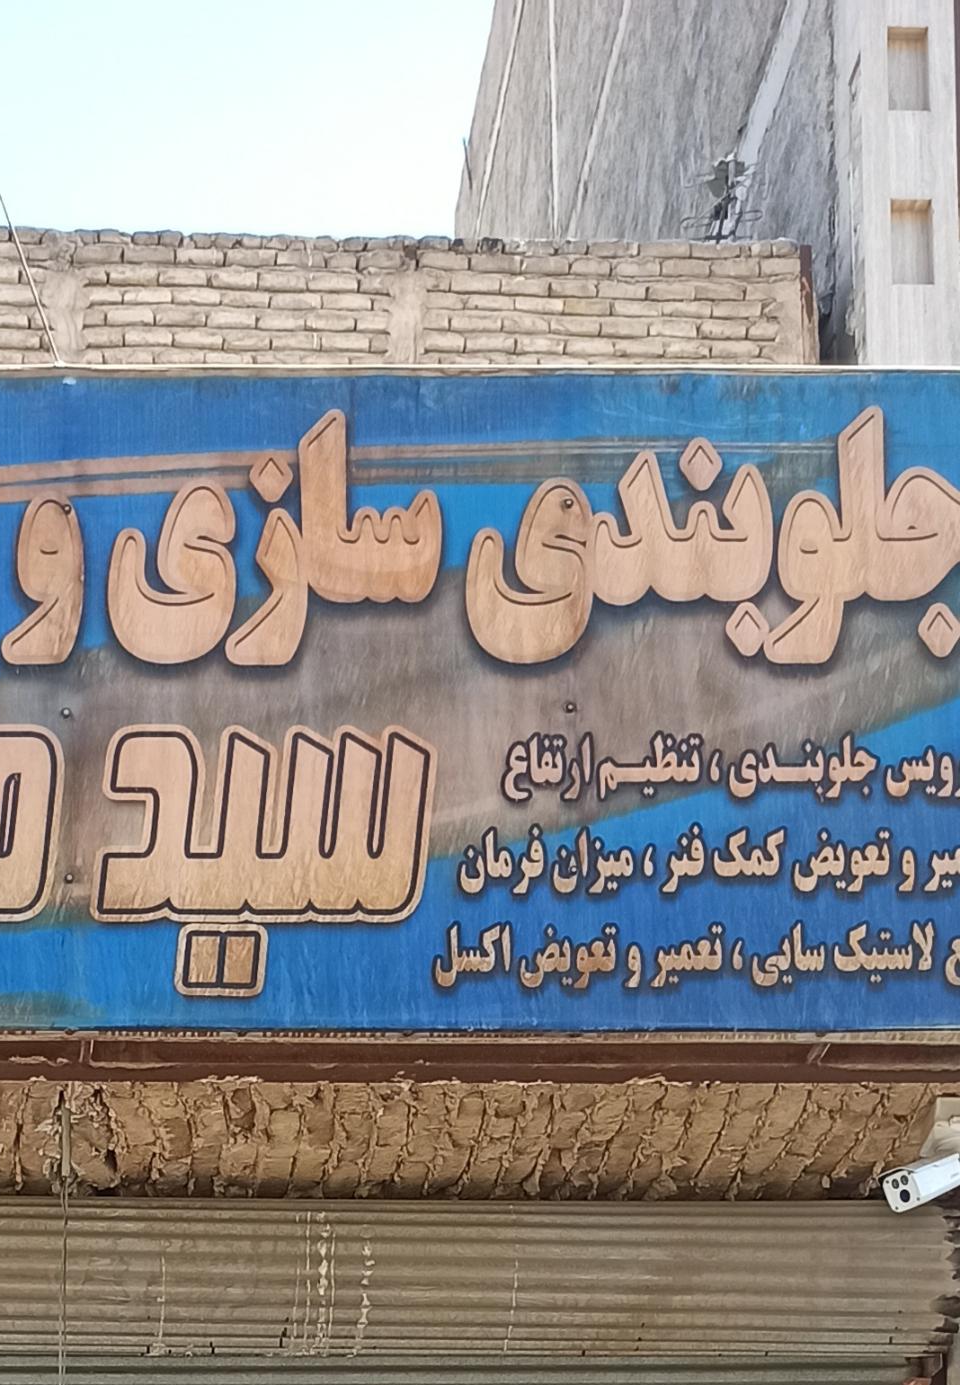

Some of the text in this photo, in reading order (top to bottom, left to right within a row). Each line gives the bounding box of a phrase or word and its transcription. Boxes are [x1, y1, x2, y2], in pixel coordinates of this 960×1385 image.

[107, 408, 440, 665] سازی
[1, 489, 85, 665] و
[501, 731, 593, 802] ارتفاع
[599, 733, 700, 799] تنظیم
[728, 735, 878, 802] جلوبندی
[94, 723, 433, 997] سید
[458, 824, 543, 895] فرمان
[552, 829, 634, 894] میزان
[660, 822, 707, 893] فنر
[712, 828, 786, 879] کمک
[793, 828, 891, 893] تعویض
[433, 925, 512, 987] اکسل
[519, 925, 617, 989] تعویض
[624, 948, 642, 988] و
[650, 922, 724, 988] تعمیر
[833, 921, 936, 985] لاستیک
